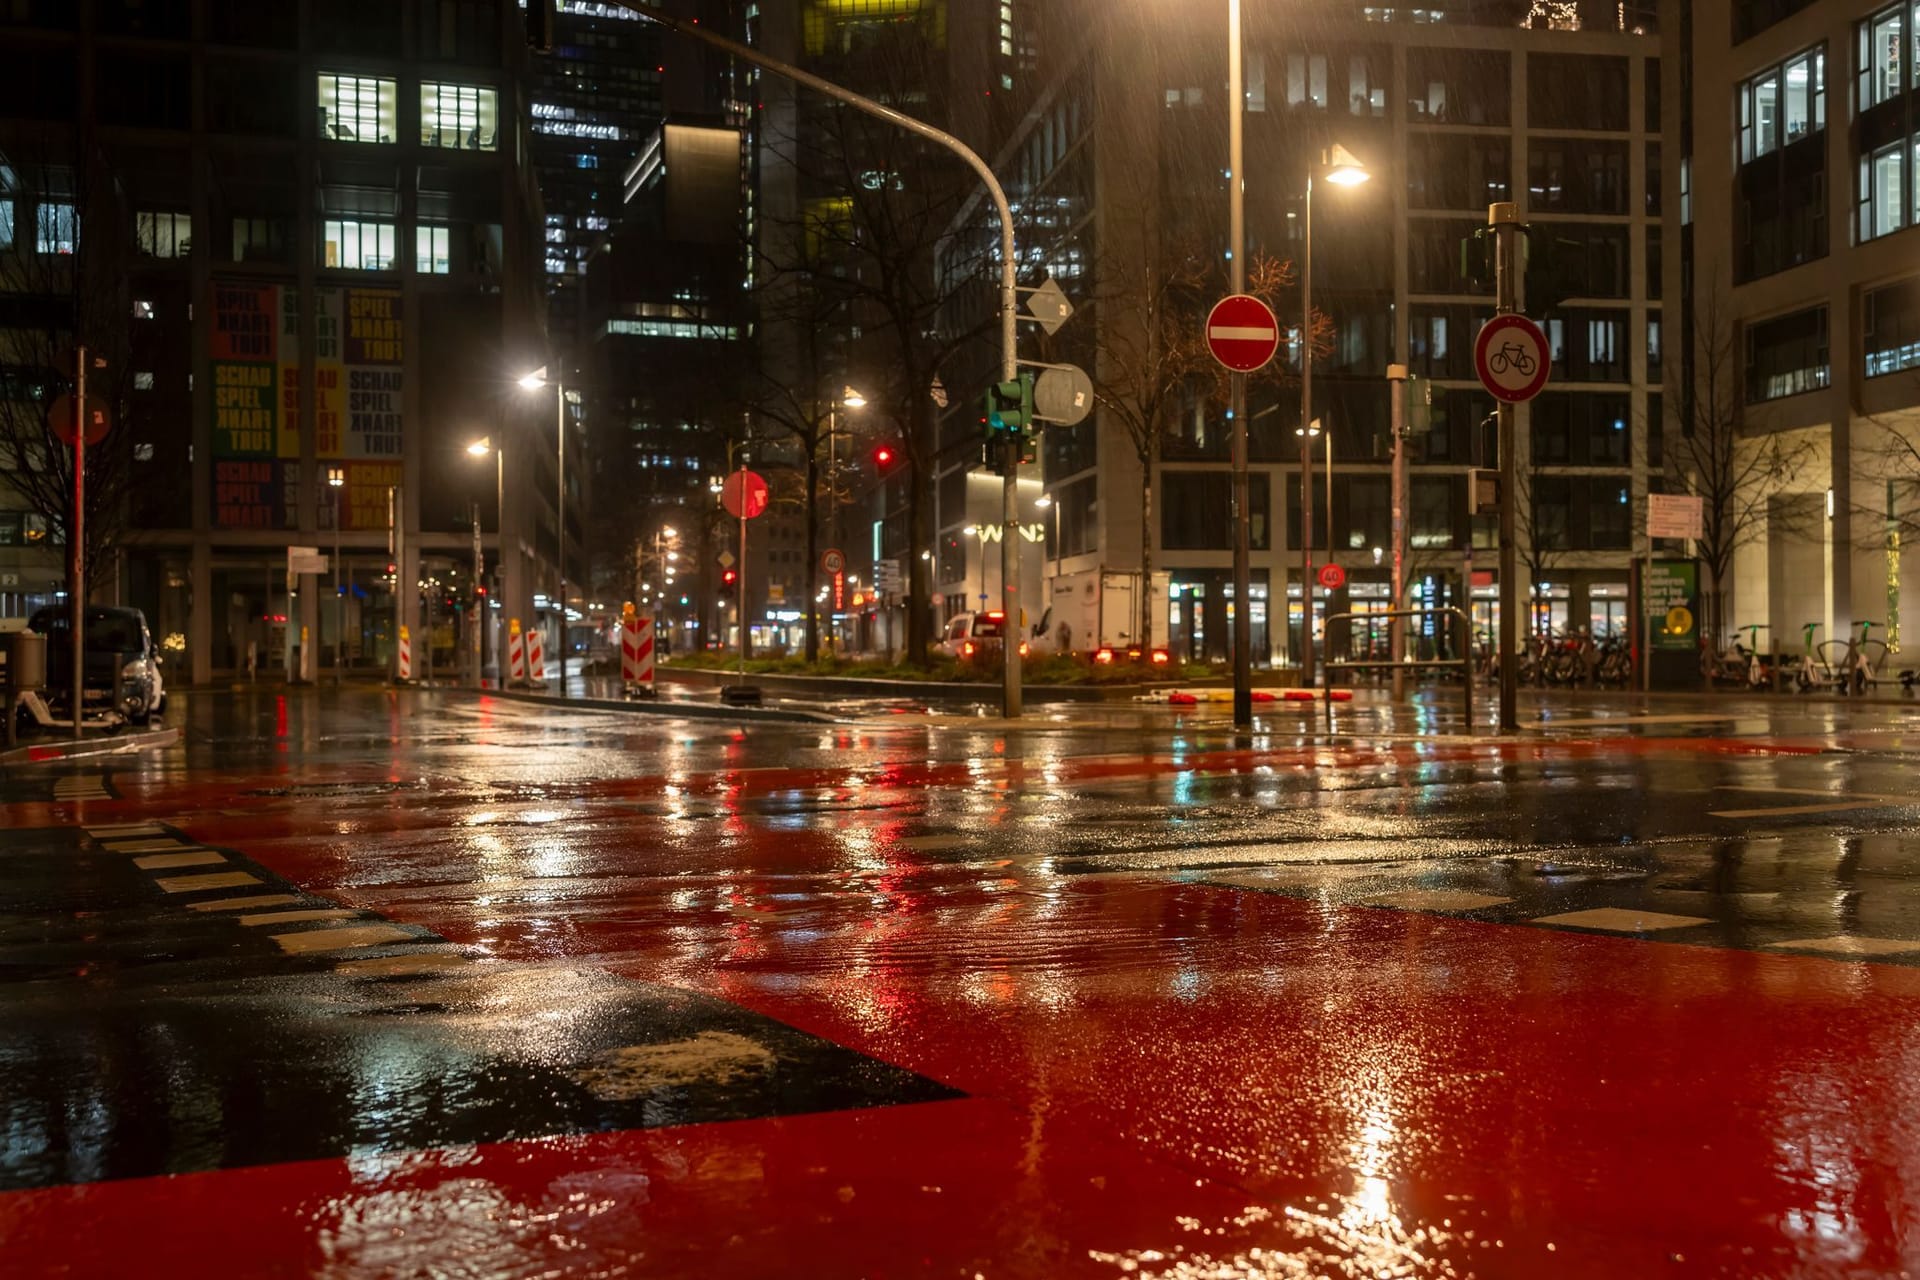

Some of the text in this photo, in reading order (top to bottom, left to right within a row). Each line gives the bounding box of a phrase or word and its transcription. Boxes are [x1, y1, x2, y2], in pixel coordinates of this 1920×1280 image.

[350, 298, 392, 318] SPIEL
[216, 366, 271, 387] SCHAU
[351, 371, 402, 391] SCHAU
[216, 388, 260, 408] SPIEL
[351, 392, 392, 412] SPIEL
[216, 461, 271, 482] SCHAU
[216, 483, 260, 504] SPIEL
[351, 486, 388, 505] SPIE
[976, 523, 1045, 543] WN
[827, 557, 840, 569] 40
[1324, 570, 1339, 582] 40
[1642, 587, 1667, 597] Sart
